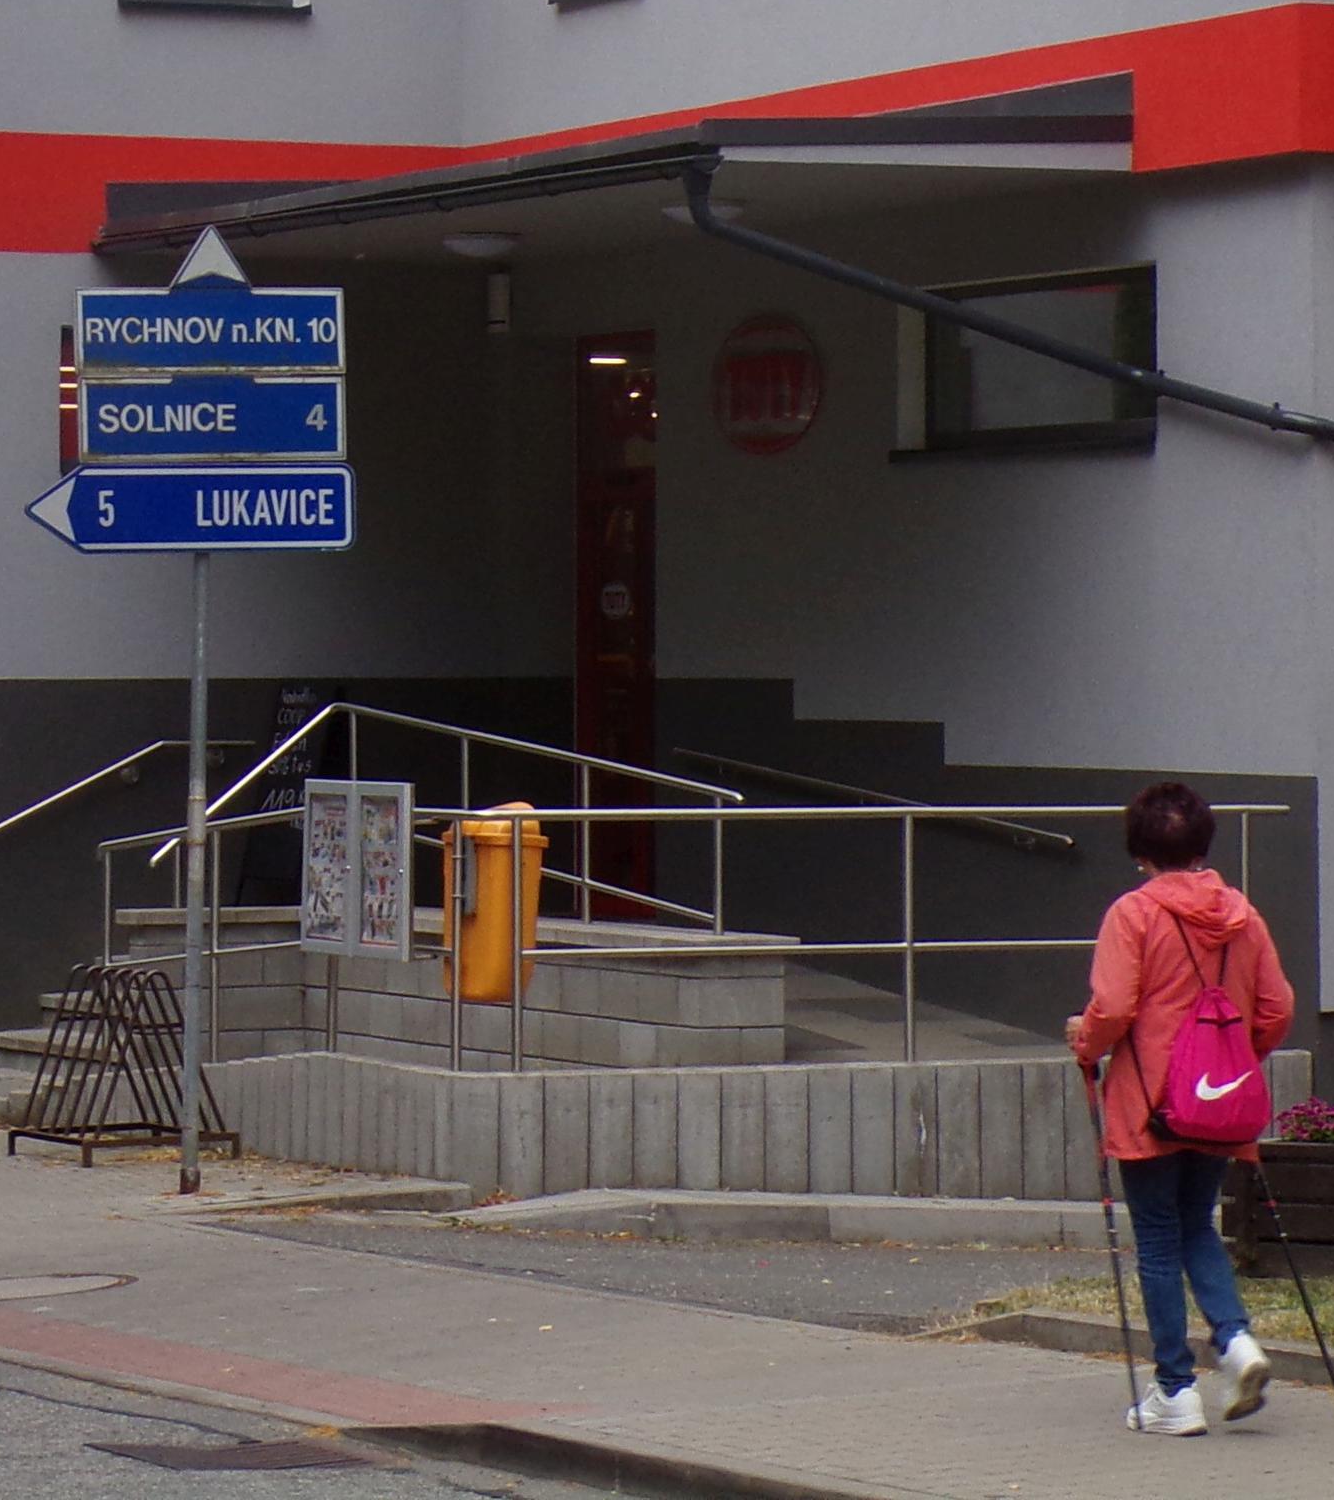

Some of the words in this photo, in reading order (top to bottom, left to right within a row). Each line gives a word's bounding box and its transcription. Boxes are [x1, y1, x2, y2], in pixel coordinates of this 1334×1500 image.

[85, 316, 224, 344] RYCHNOV
[232, 317, 301, 344] n.KN.
[307, 317, 336, 343] 10
[98, 402, 237, 433] SOLNICE
[305, 404, 328, 432] 4
[97, 490, 115, 528] 5
[196, 488, 335, 527] LUKAVICE
